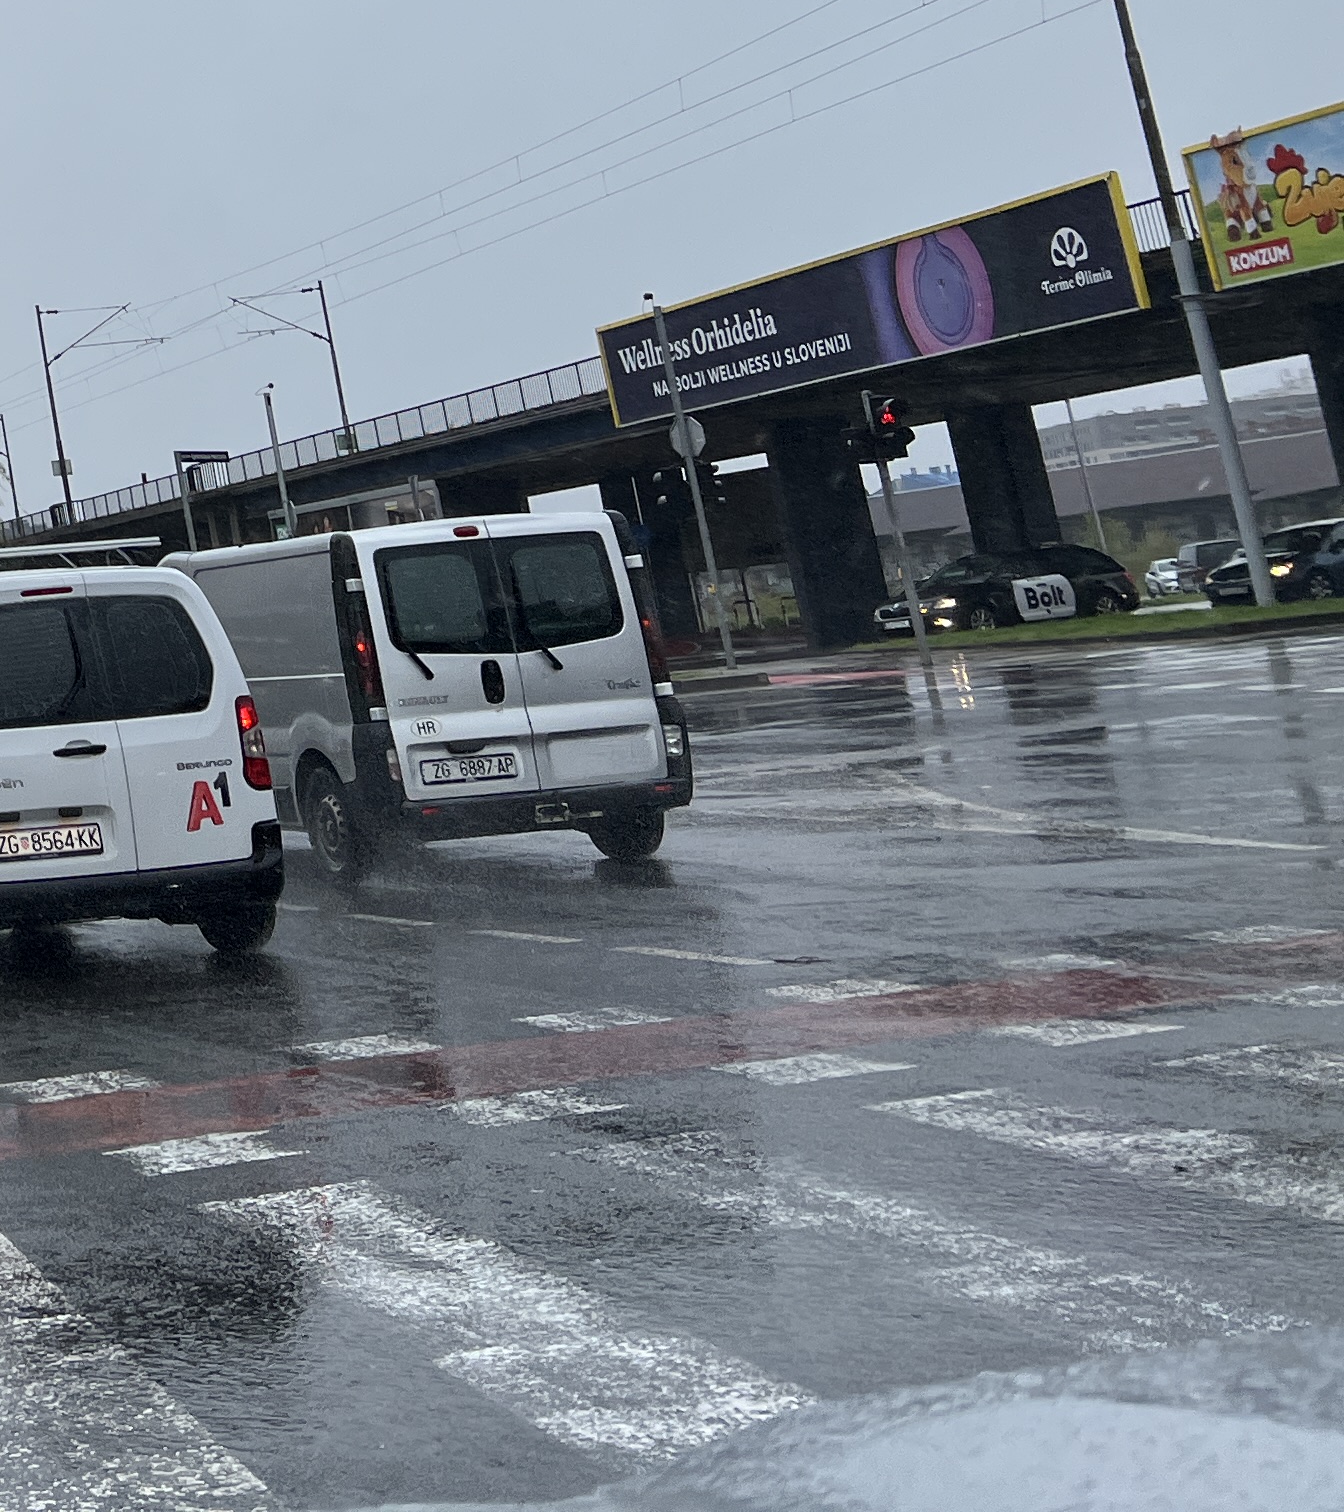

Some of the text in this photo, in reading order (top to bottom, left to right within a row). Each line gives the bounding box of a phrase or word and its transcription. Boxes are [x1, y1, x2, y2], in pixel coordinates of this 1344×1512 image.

[1229, 244, 1291, 273] KONZUM
[1041, 267, 1113, 295] Terme Olimia
[691, 307, 778, 357] Orhidelia
[652, 333, 852, 398] NABOLJI WELLNESS U SLOVENIJI
[1023, 583, 1066, 610] Bolt
[417, 720, 437, 736] HR
[432, 763, 451, 779] ZG
[186, 771, 232, 833] A1
